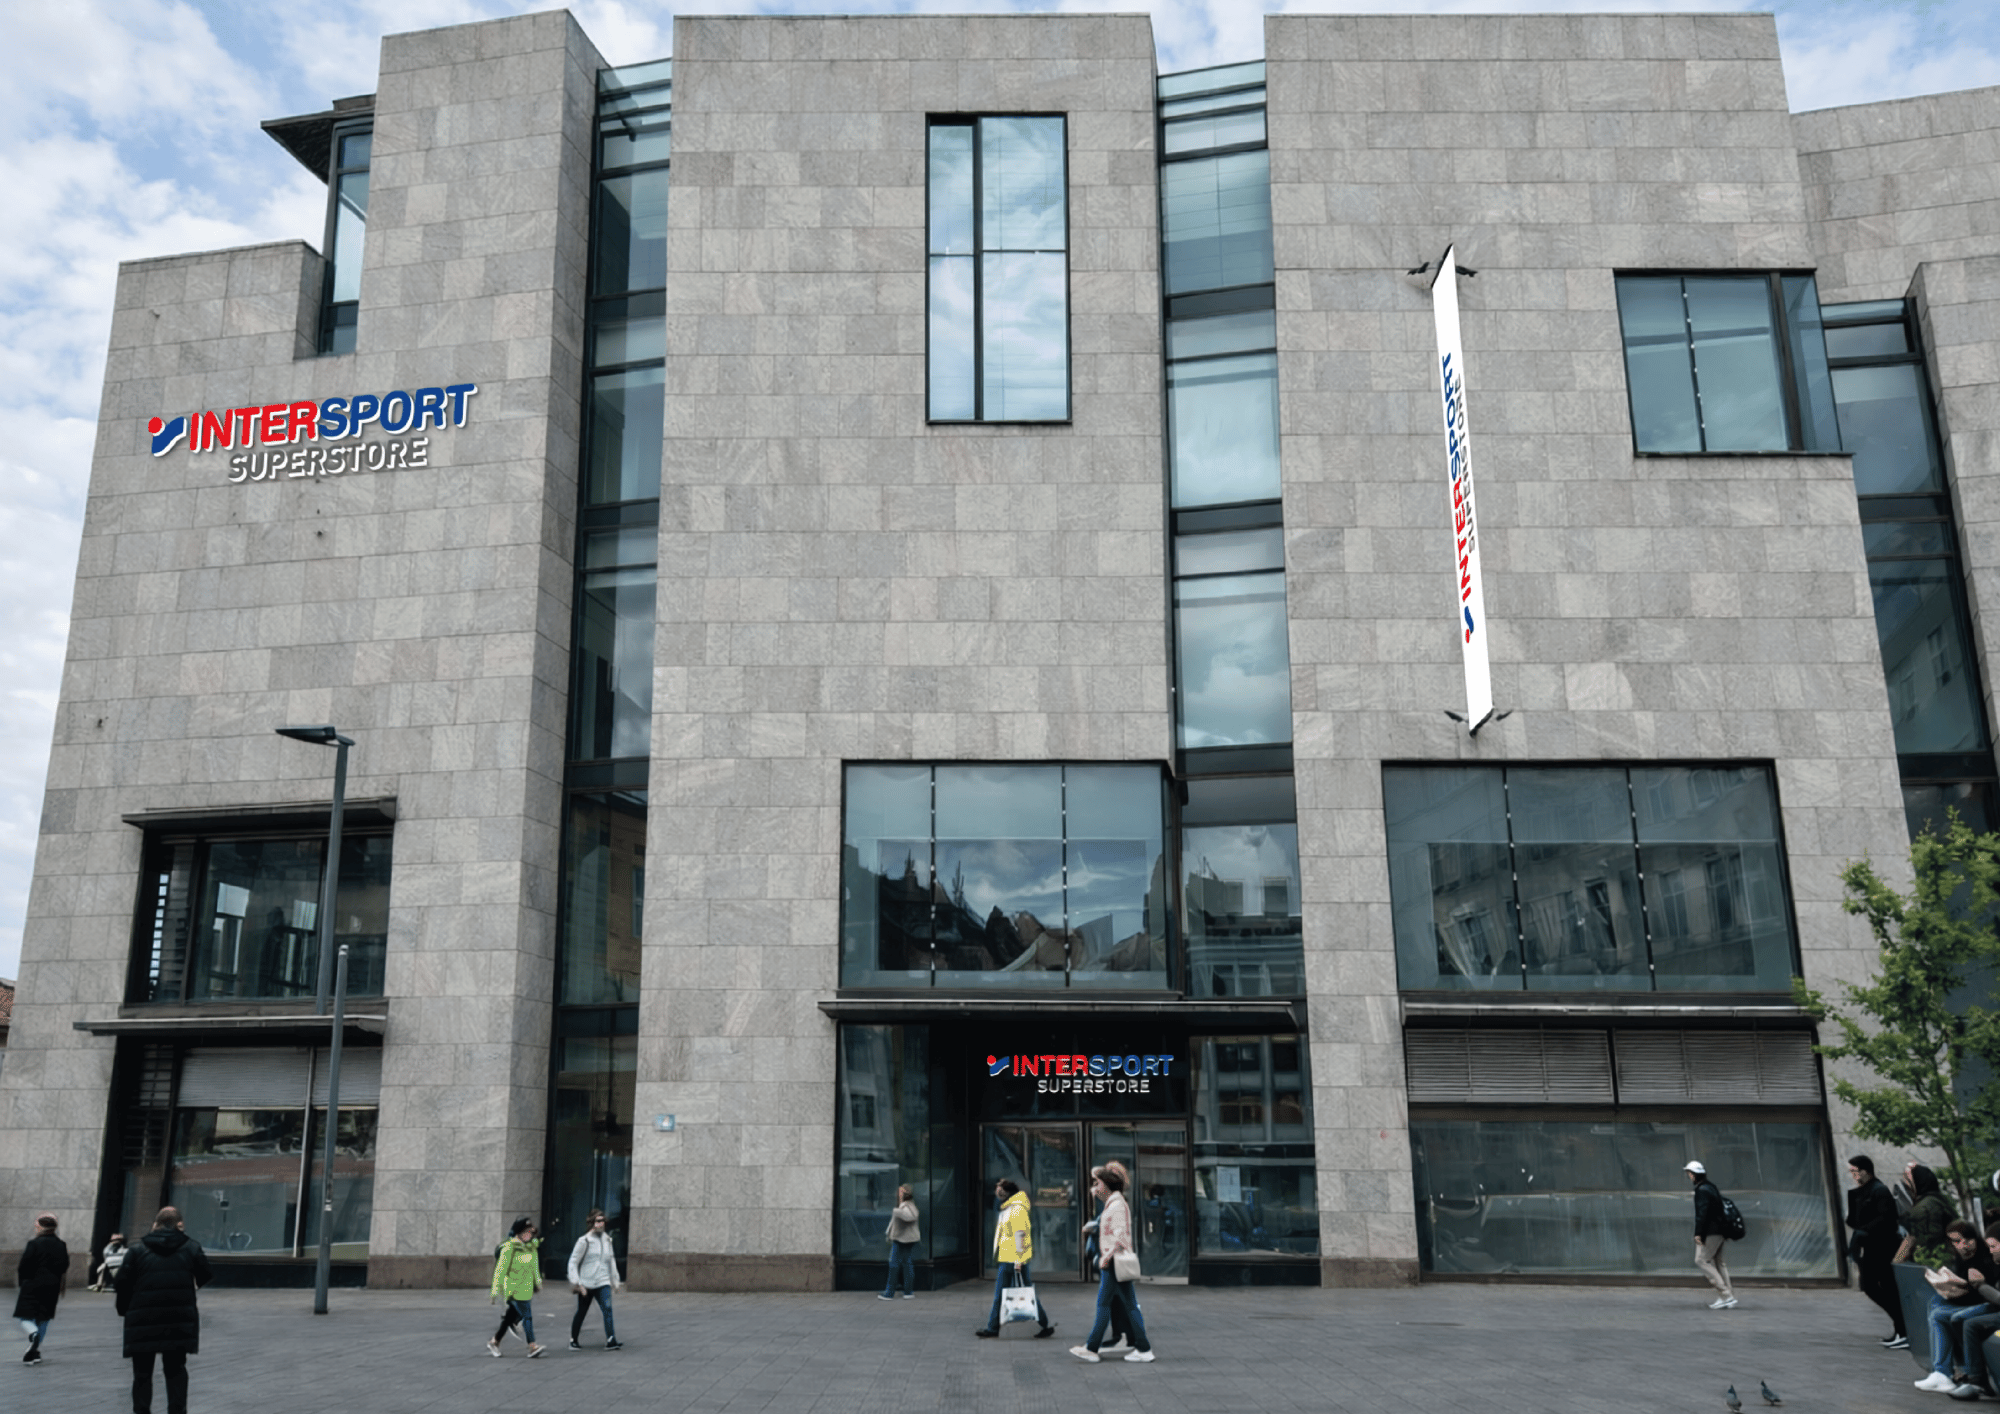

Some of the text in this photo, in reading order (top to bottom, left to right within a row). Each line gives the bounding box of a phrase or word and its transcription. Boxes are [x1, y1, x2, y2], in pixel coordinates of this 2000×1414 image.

[190, 383, 478, 454] INTERSPORT
[228, 437, 429, 483] SUPERSTORE
[1442, 352, 1472, 603] INTERSPORT
[1454, 372, 1476, 555] SUPERSTORE
[1013, 1055, 1175, 1076] INTERSPORT
[1037, 1079, 1151, 1094] SUPERSTORE
